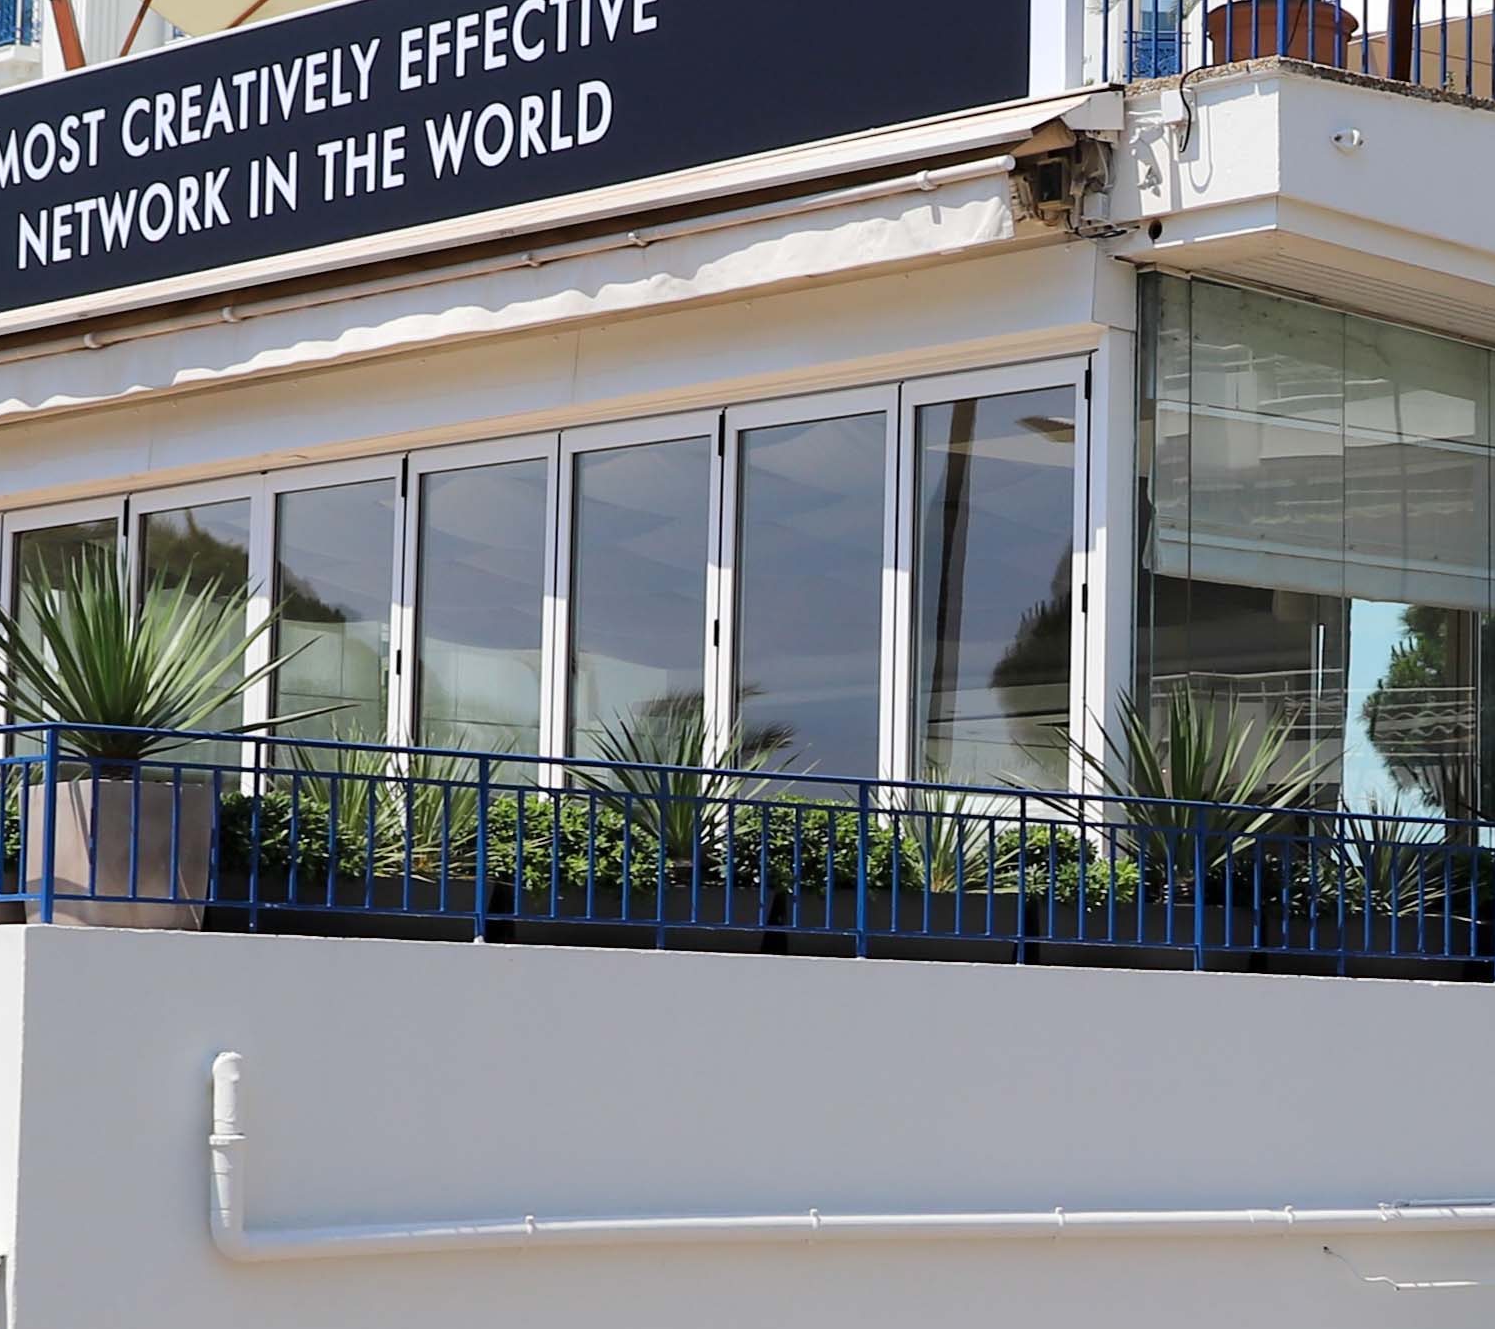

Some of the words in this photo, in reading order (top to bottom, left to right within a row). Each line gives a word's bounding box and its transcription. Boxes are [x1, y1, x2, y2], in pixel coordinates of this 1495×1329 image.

[17, 166, 231, 270] NETWORK
[249, 151, 299, 218] IN
[317, 125, 406, 202] THE
[425, 79, 613, 180] WORLD
[121, 37, 381, 158] CREATIVELY
